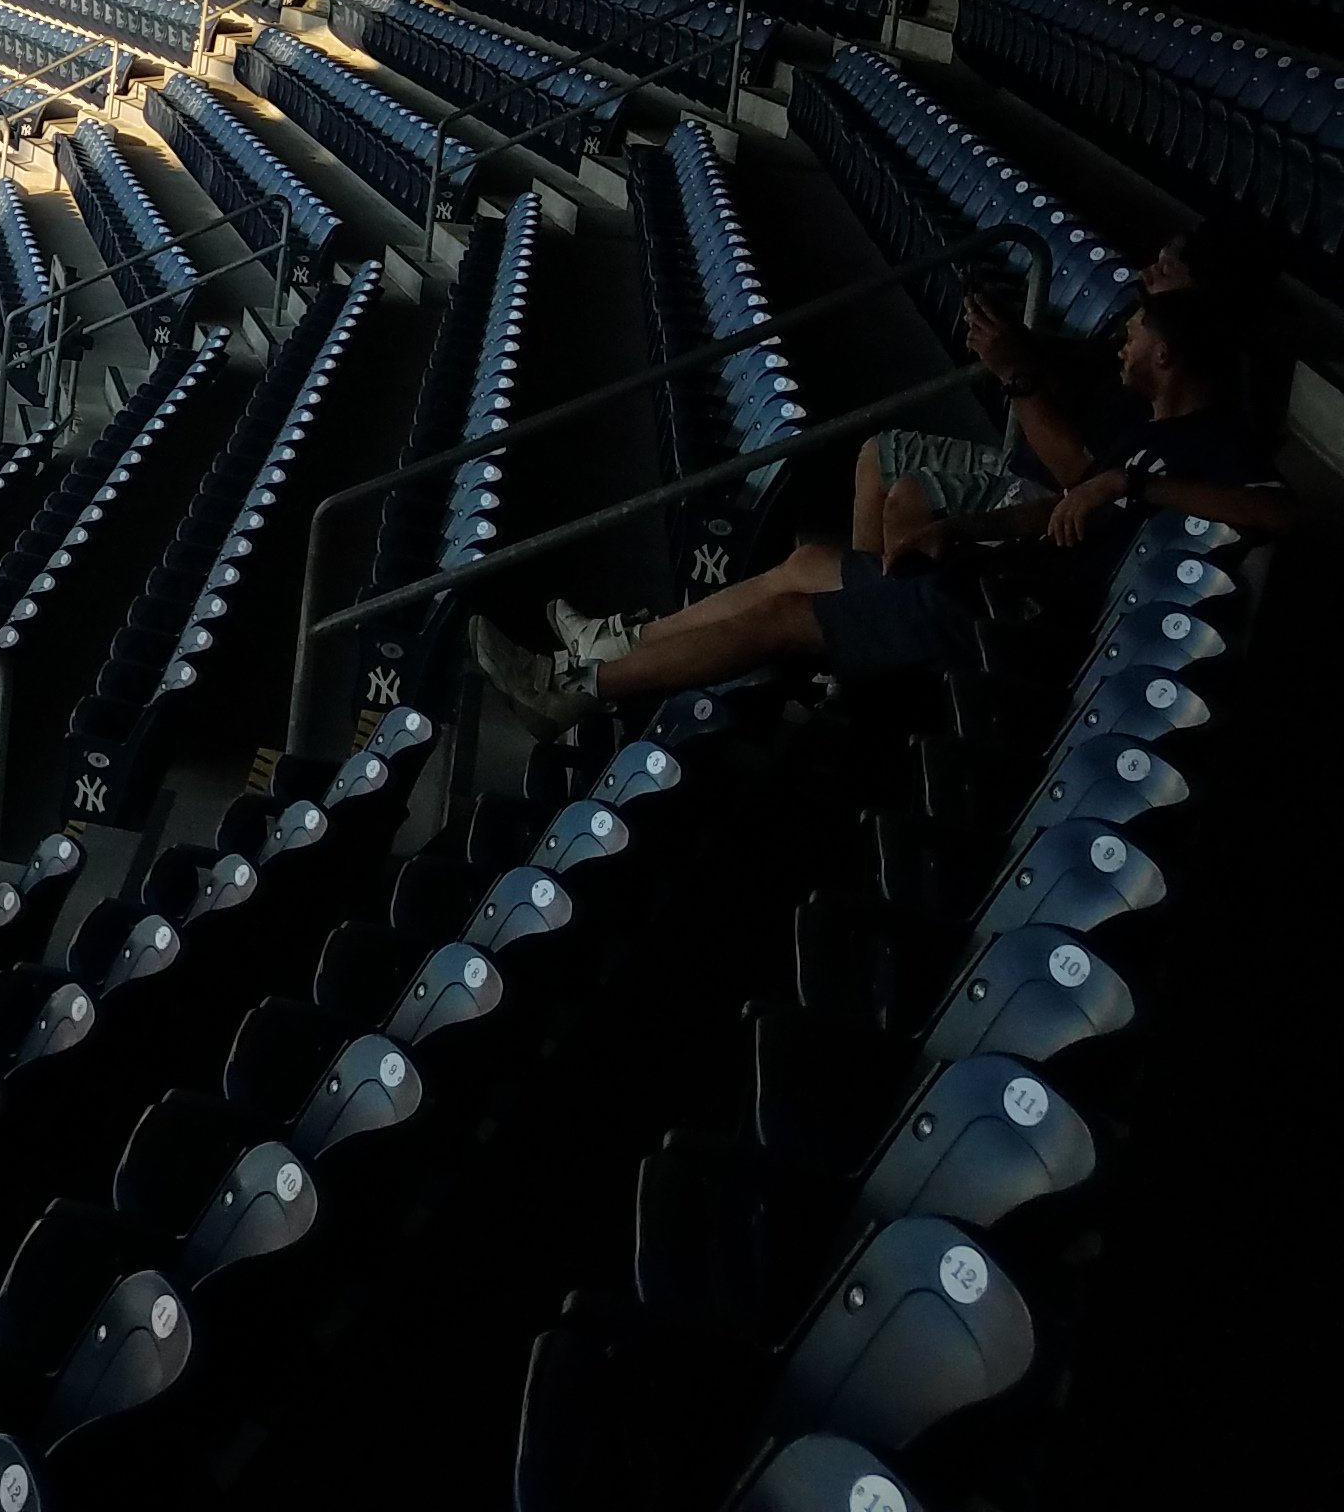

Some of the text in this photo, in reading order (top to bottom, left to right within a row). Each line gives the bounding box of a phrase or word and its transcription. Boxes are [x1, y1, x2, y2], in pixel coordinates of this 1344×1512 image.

[1059, 955, 1081, 978] 10
[1014, 1089, 1038, 1115] 11
[281, 1172, 297, 1193] 10
[951, 1260, 977, 1290] 12
[157, 1306, 171, 1329] 11
[6, 1477, 22, 1503] 12
[864, 1493, 894, 1512] 1
